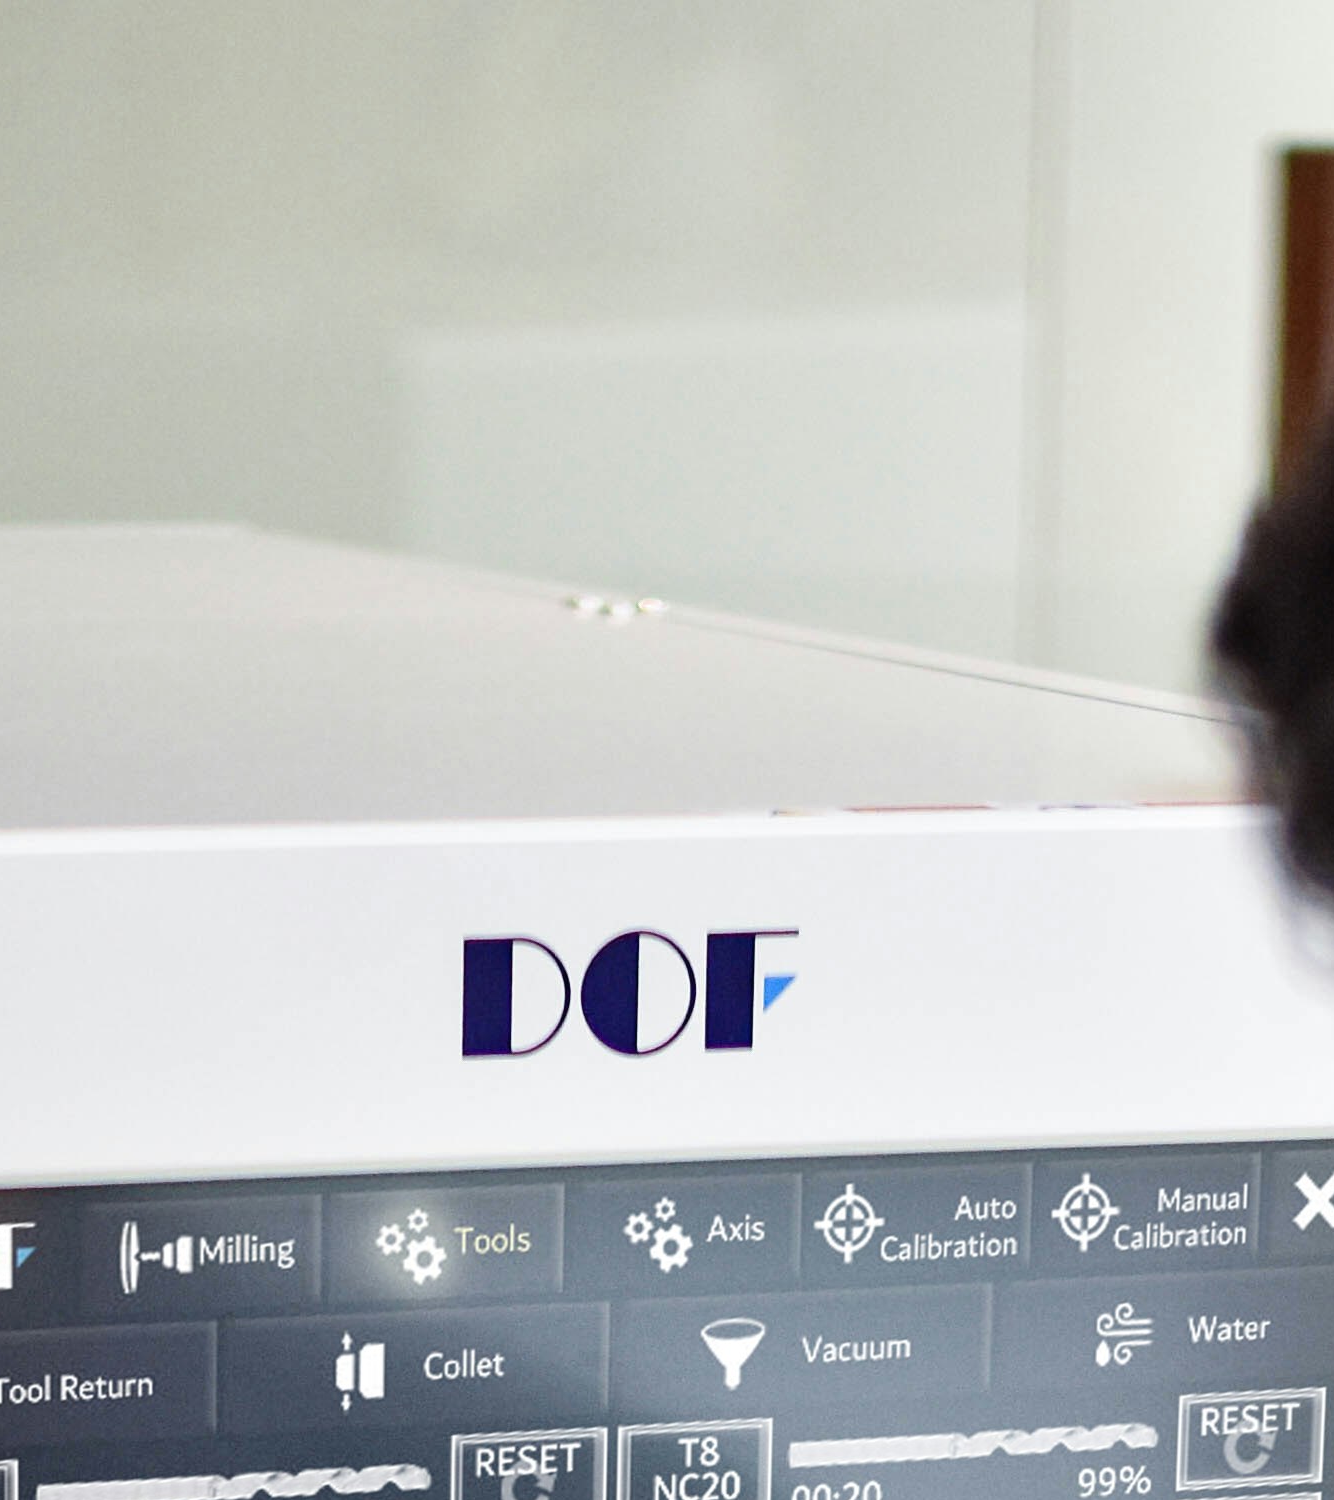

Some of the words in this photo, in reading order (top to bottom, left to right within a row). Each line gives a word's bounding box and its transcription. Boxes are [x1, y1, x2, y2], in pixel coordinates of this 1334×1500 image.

[463, 930, 799, 1056] DOF
[955, 1196, 1016, 1220] Auto
[1158, 1184, 1247, 1212] Manual
[454, 1224, 530, 1254] Tools
[707, 1215, 764, 1242] Axis
[1114, 1222, 1246, 1250] Calibration
[200, 1234, 295, 1268] Milling
[881, 1233, 1016, 1261] Calibration
[1189, 1316, 1270, 1342] Water
[424, 1349, 504, 1379] Collet
[803, 1337, 910, 1362] Vacuum
[61, 1375, 152, 1400] Return
[1201, 1403, 1300, 1439] RESET
[476, 1442, 580, 1477] RESET
[679, 1438, 720, 1468] T8
[1079, 1466, 1151, 1497] 99%
